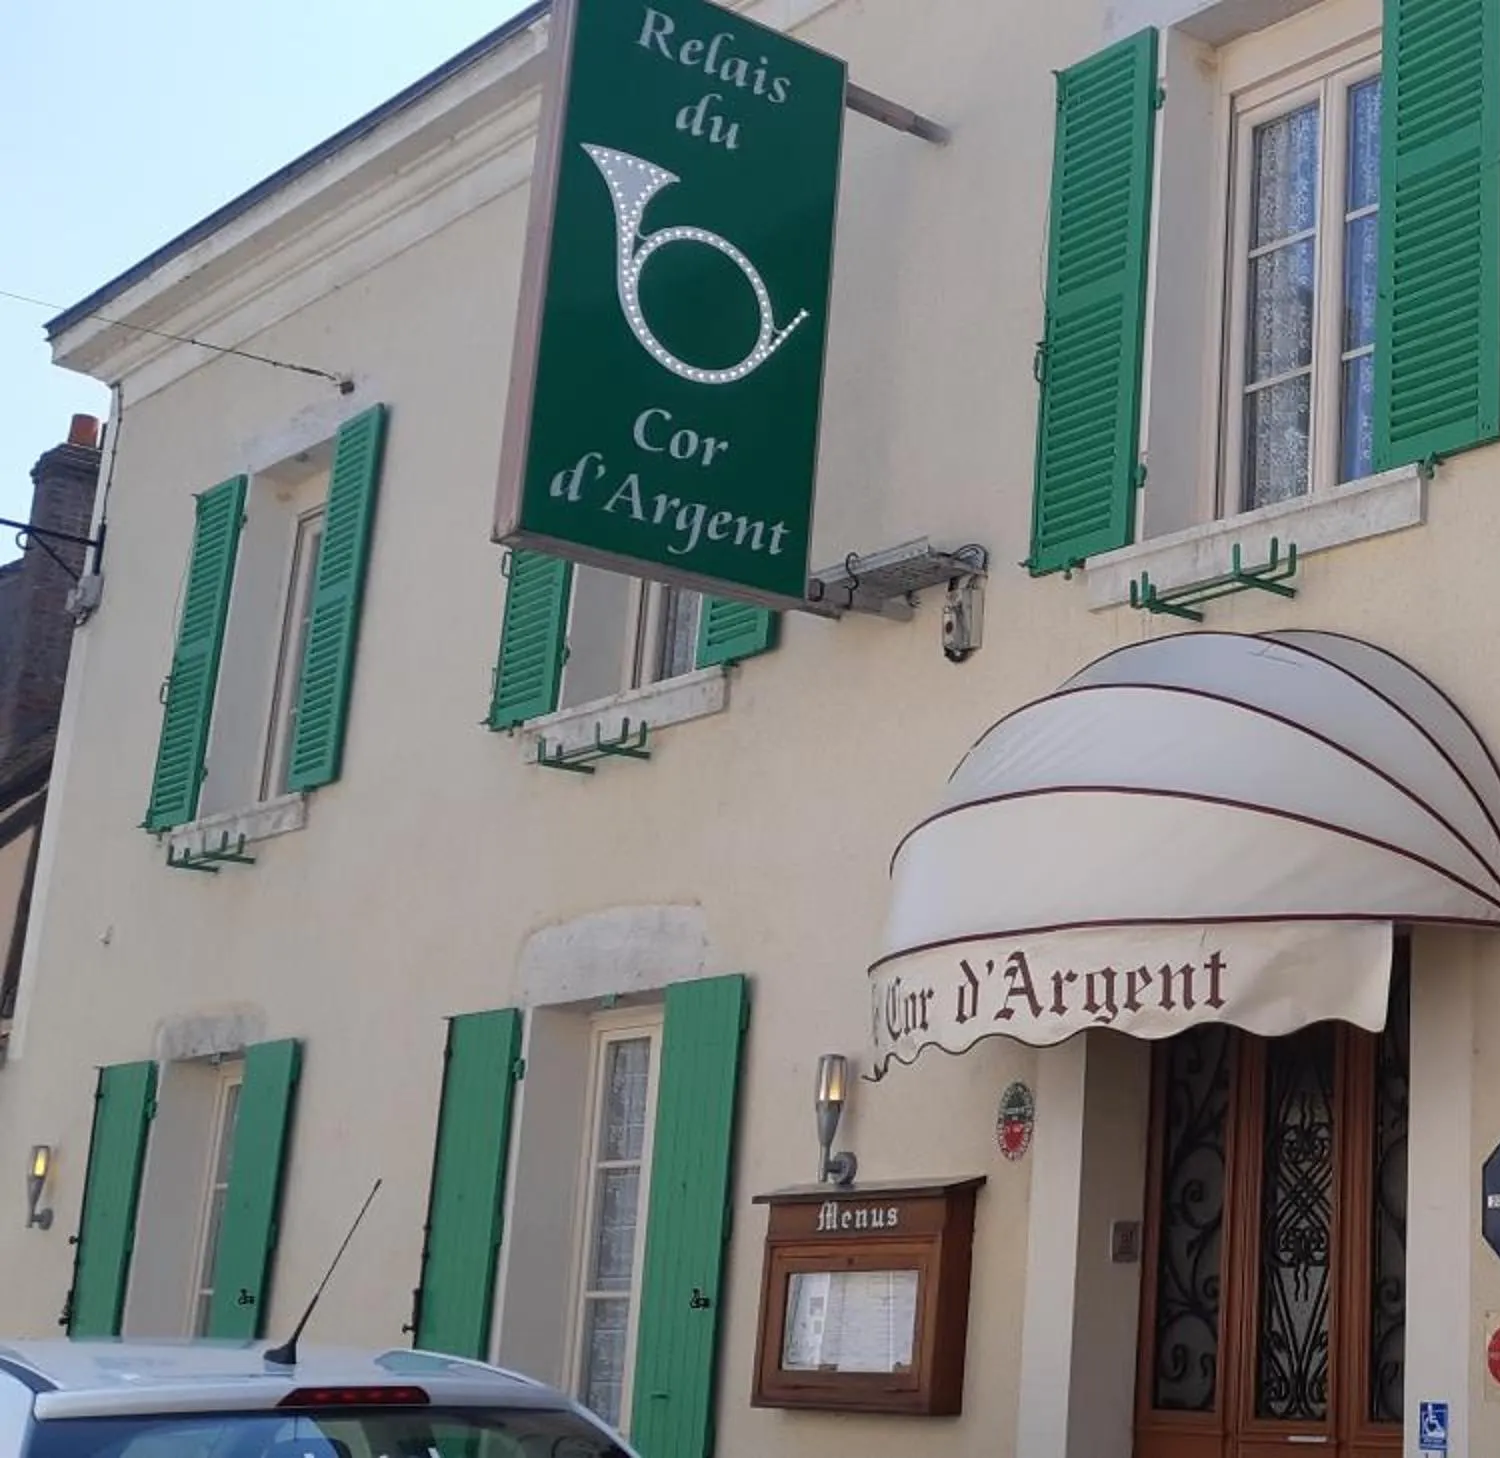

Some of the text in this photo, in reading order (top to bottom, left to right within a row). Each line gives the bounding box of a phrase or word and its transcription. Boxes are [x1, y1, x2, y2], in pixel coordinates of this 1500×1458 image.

[639, 6, 791, 105] Relais
[675, 93, 741, 150] du
[633, 407, 729, 467] Cor
[549, 451, 791, 556] d'Argent
[885, 975, 935, 1041] Cor
[954, 949, 1228, 1025] d'Argent
[816, 1201, 900, 1231] Menus
